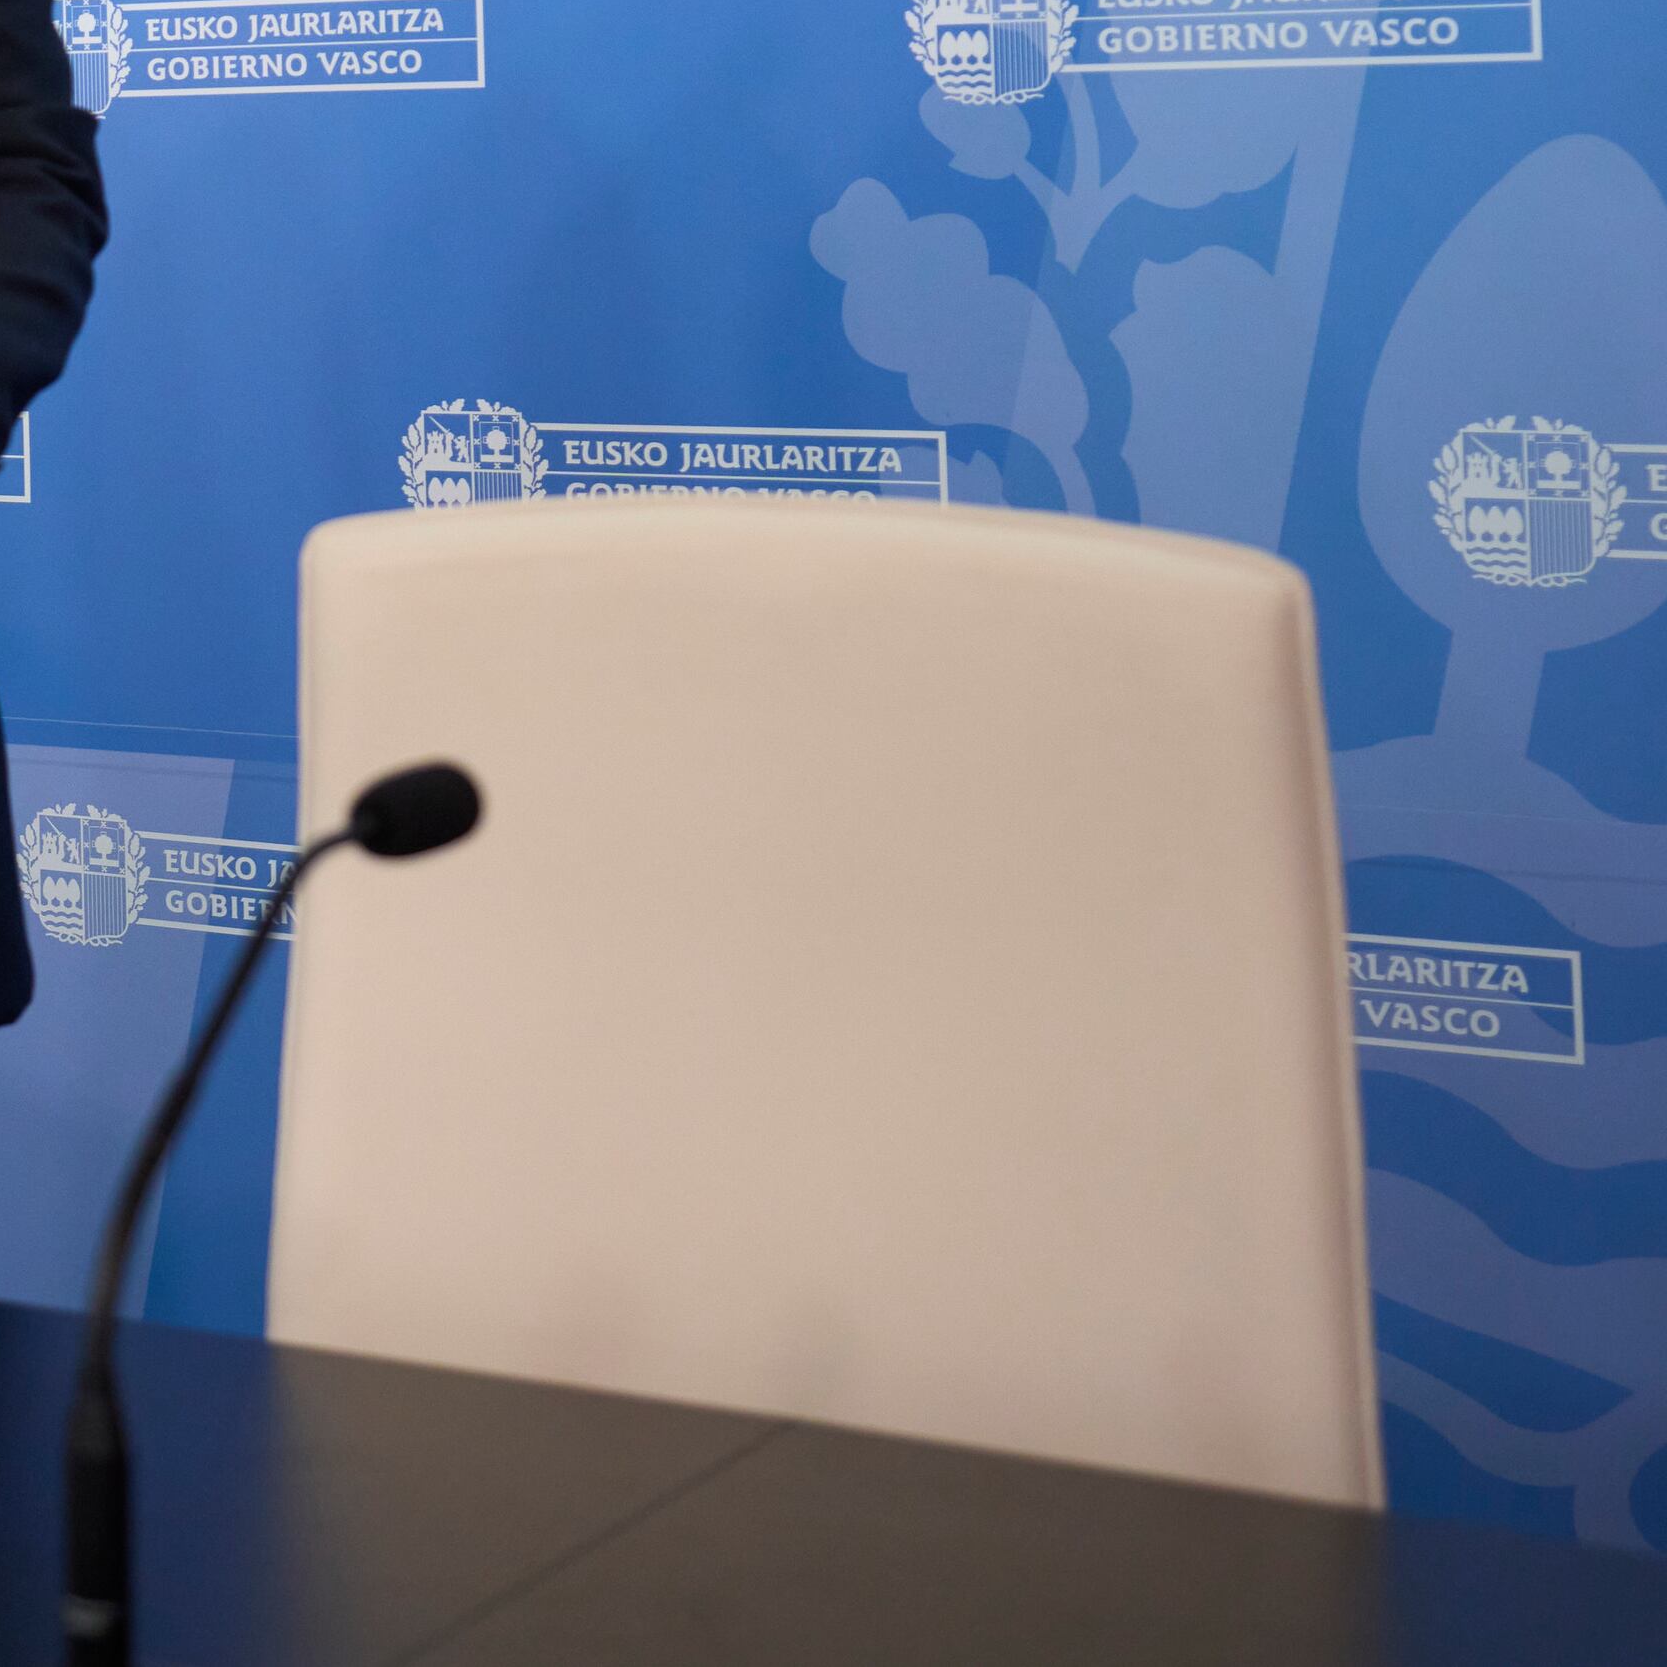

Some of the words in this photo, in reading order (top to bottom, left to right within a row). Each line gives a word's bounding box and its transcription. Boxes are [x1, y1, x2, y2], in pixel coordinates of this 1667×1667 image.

[145, 15, 238, 42] EUSKO
[248, 8, 444, 43] JAURLARITZA
[1098, 21, 1308, 54] GOBIERNO
[1320, 16, 1459, 48] VASCO
[147, 52, 308, 81] GOBIERNO
[317, 49, 422, 76] VASCO
[563, 440, 668, 466] EUSKO
[679, 442, 903, 473] JAURLARITZA
[163, 849, 257, 881] EUSKO
[1346, 951, 1529, 994] RLARITZA
[1360, 999, 1500, 1037] VASCO
